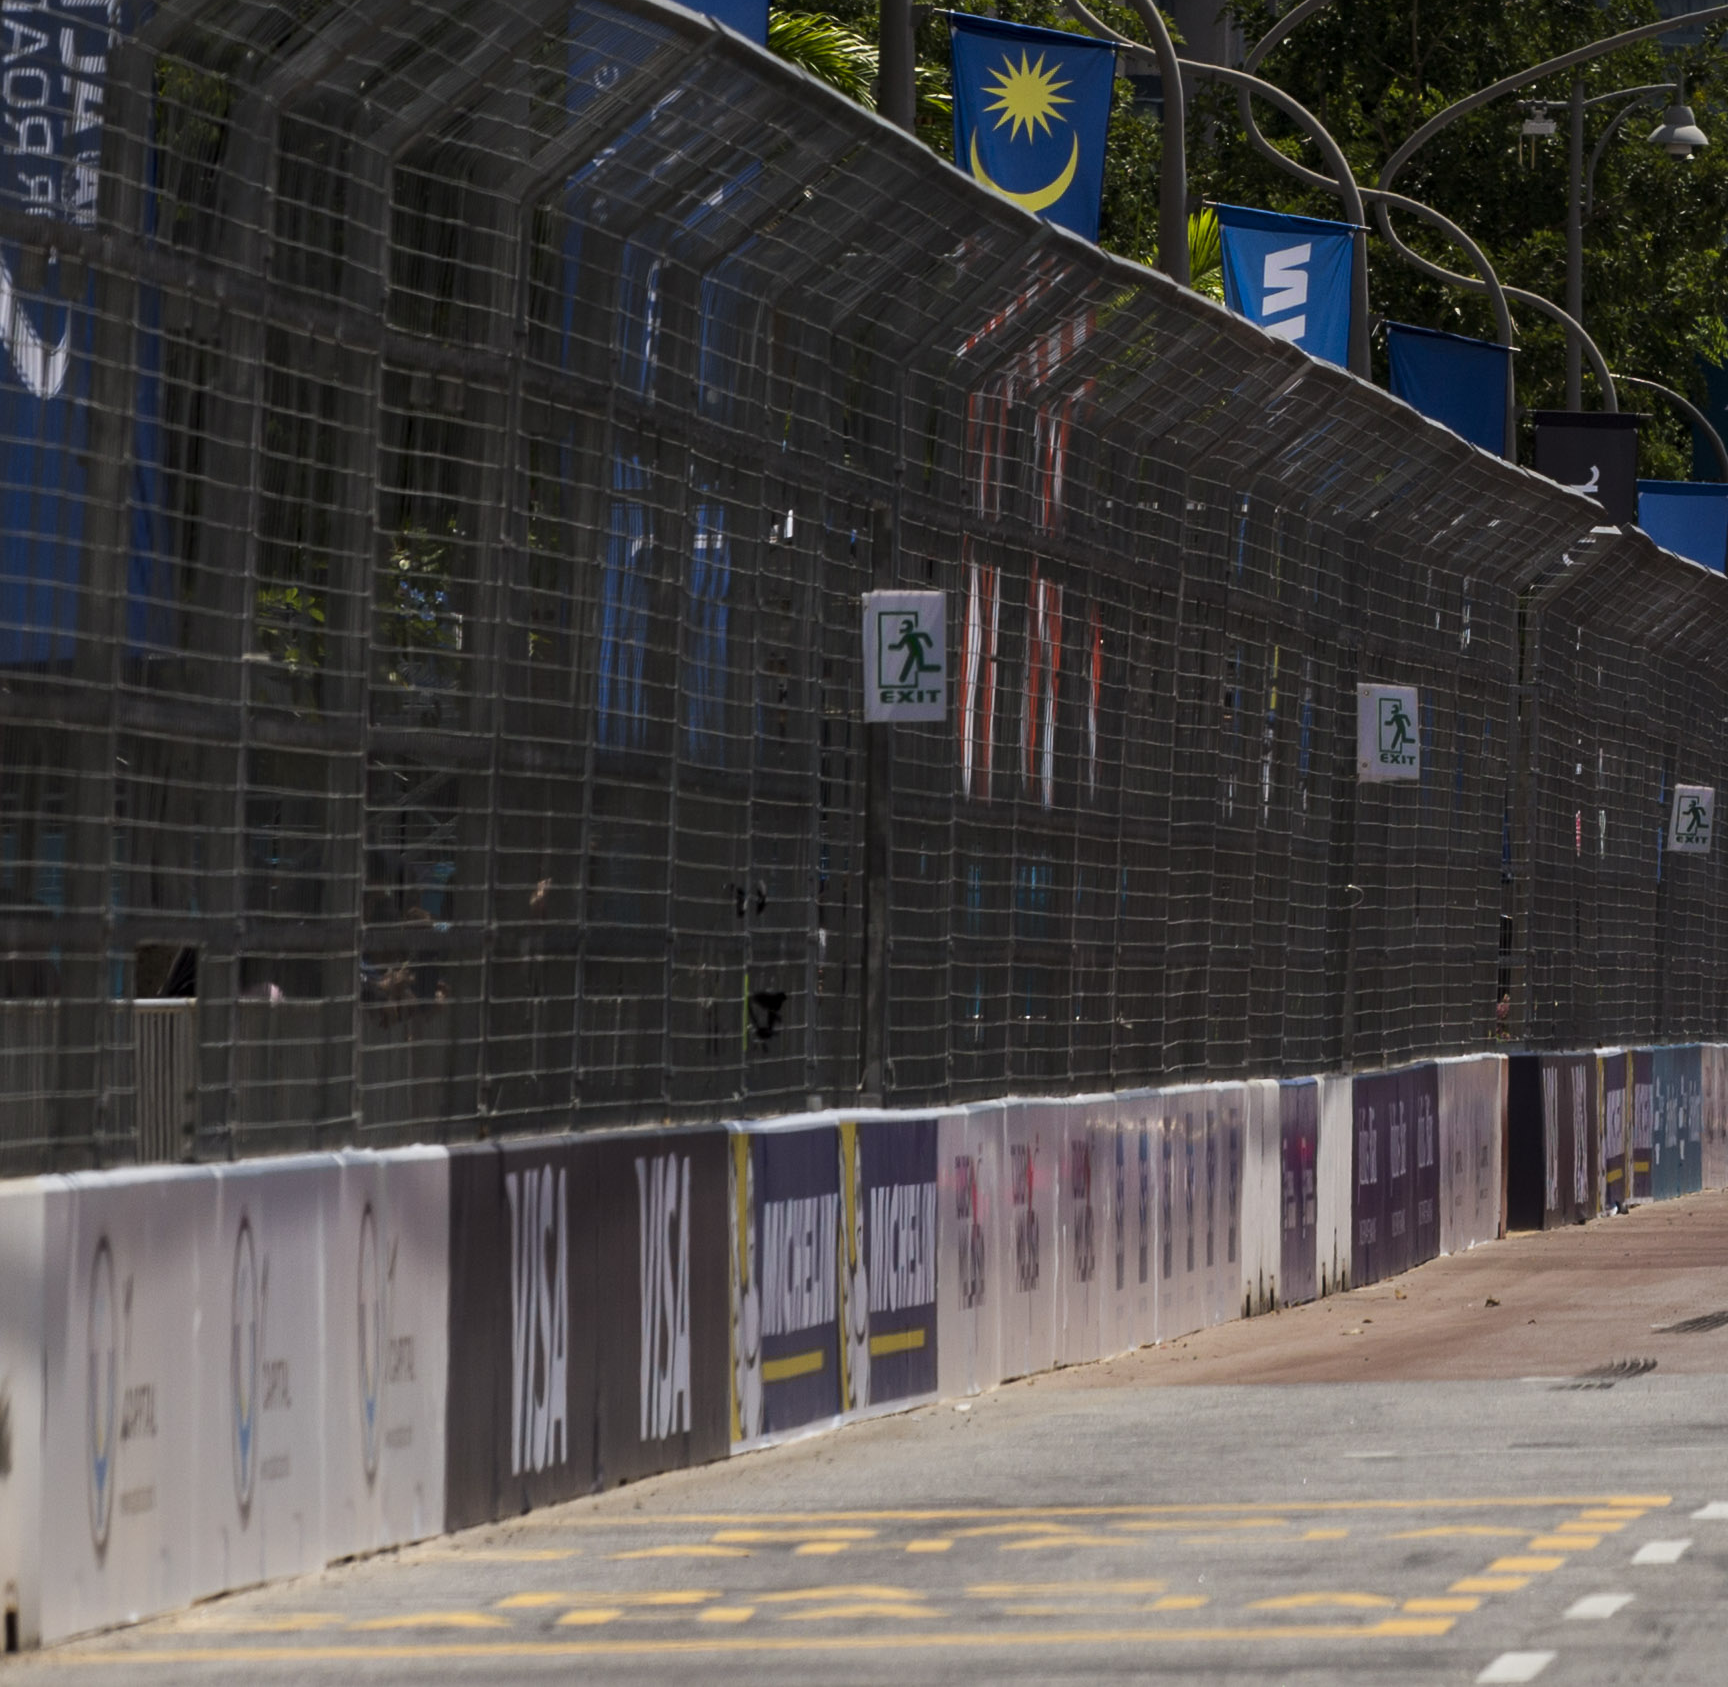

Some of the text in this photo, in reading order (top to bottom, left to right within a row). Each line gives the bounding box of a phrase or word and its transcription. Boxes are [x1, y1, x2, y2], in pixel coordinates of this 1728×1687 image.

[880, 687, 942, 705] EXIT
[1380, 752, 1415, 765] EXIT
[1676, 835, 1709, 845] EXIT
[635, 1151, 691, 1443] VISA
[505, 1162, 568, 1477] VISA
